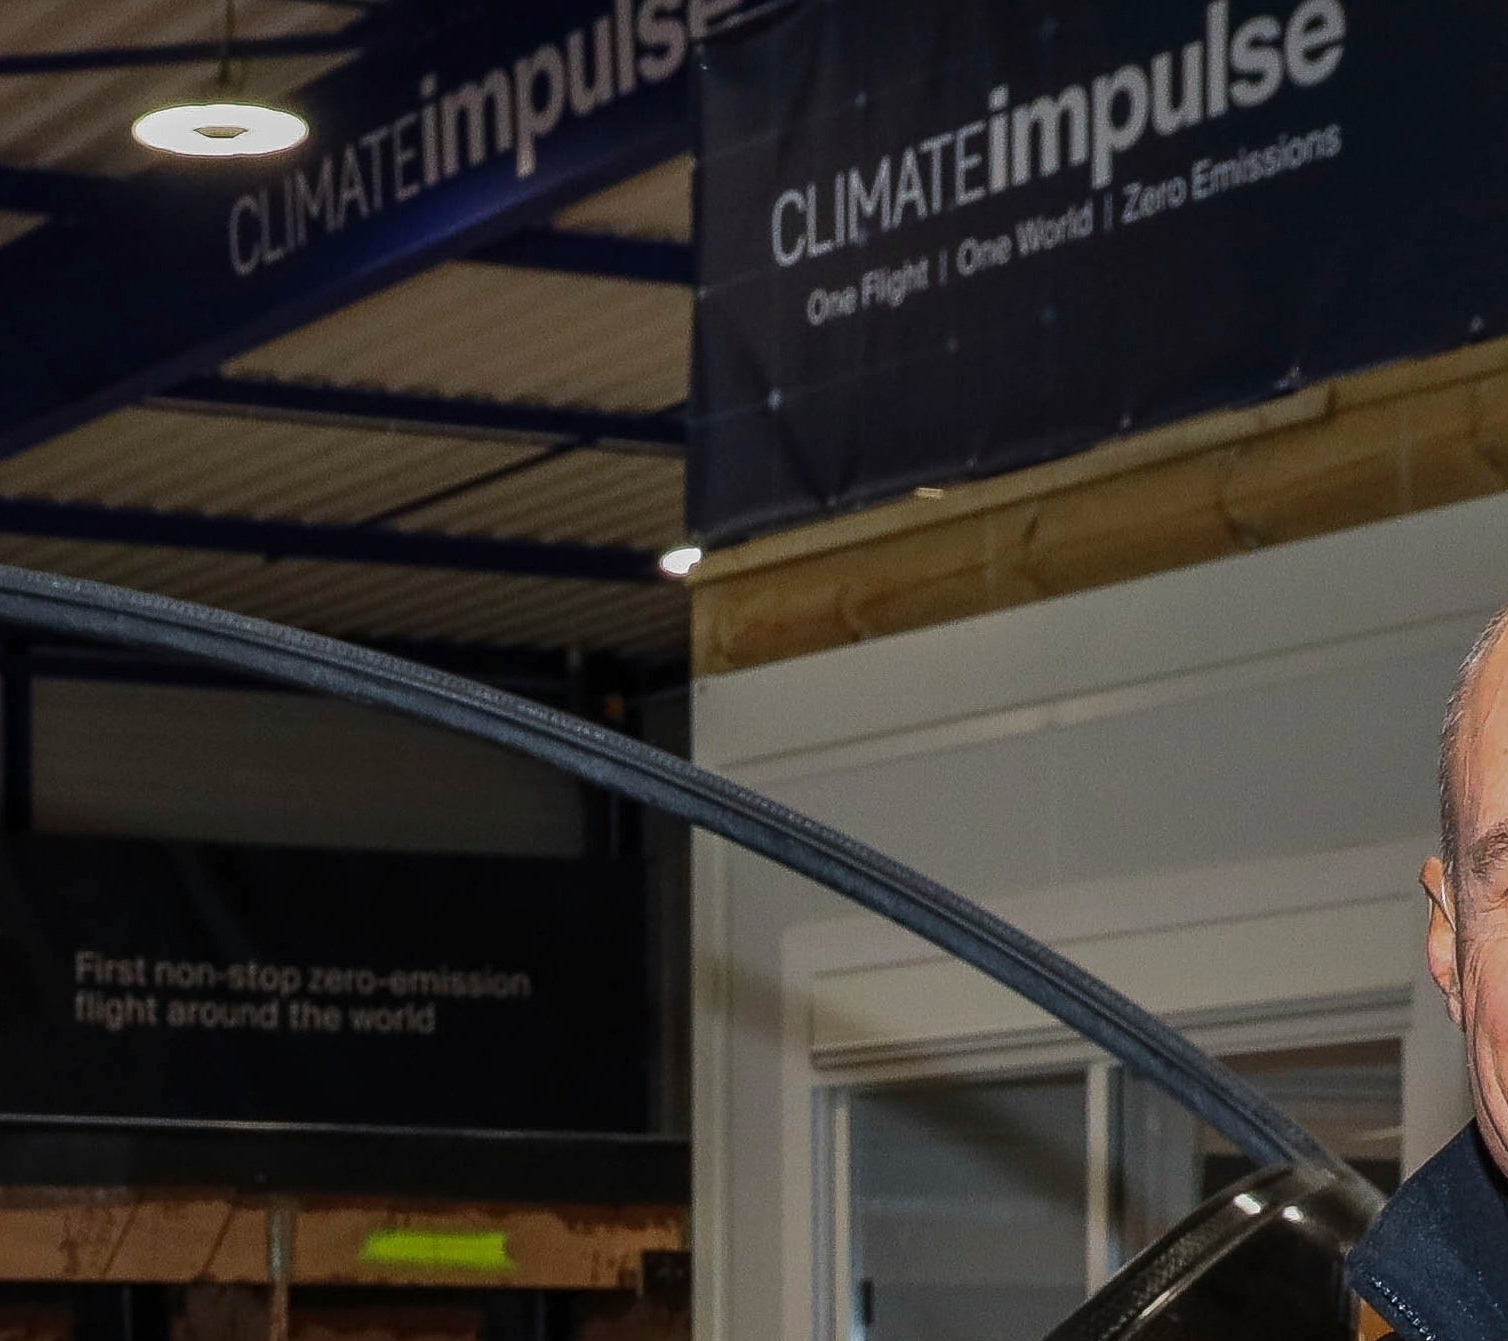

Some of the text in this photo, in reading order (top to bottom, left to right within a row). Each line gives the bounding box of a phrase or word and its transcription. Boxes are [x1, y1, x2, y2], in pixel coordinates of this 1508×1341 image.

[806, 124, 1342, 326] One Flight One World Zero Emissions
[75, 951, 532, 998] First non-stop zero-emission
[75, 992, 436, 1034] flight around the world
